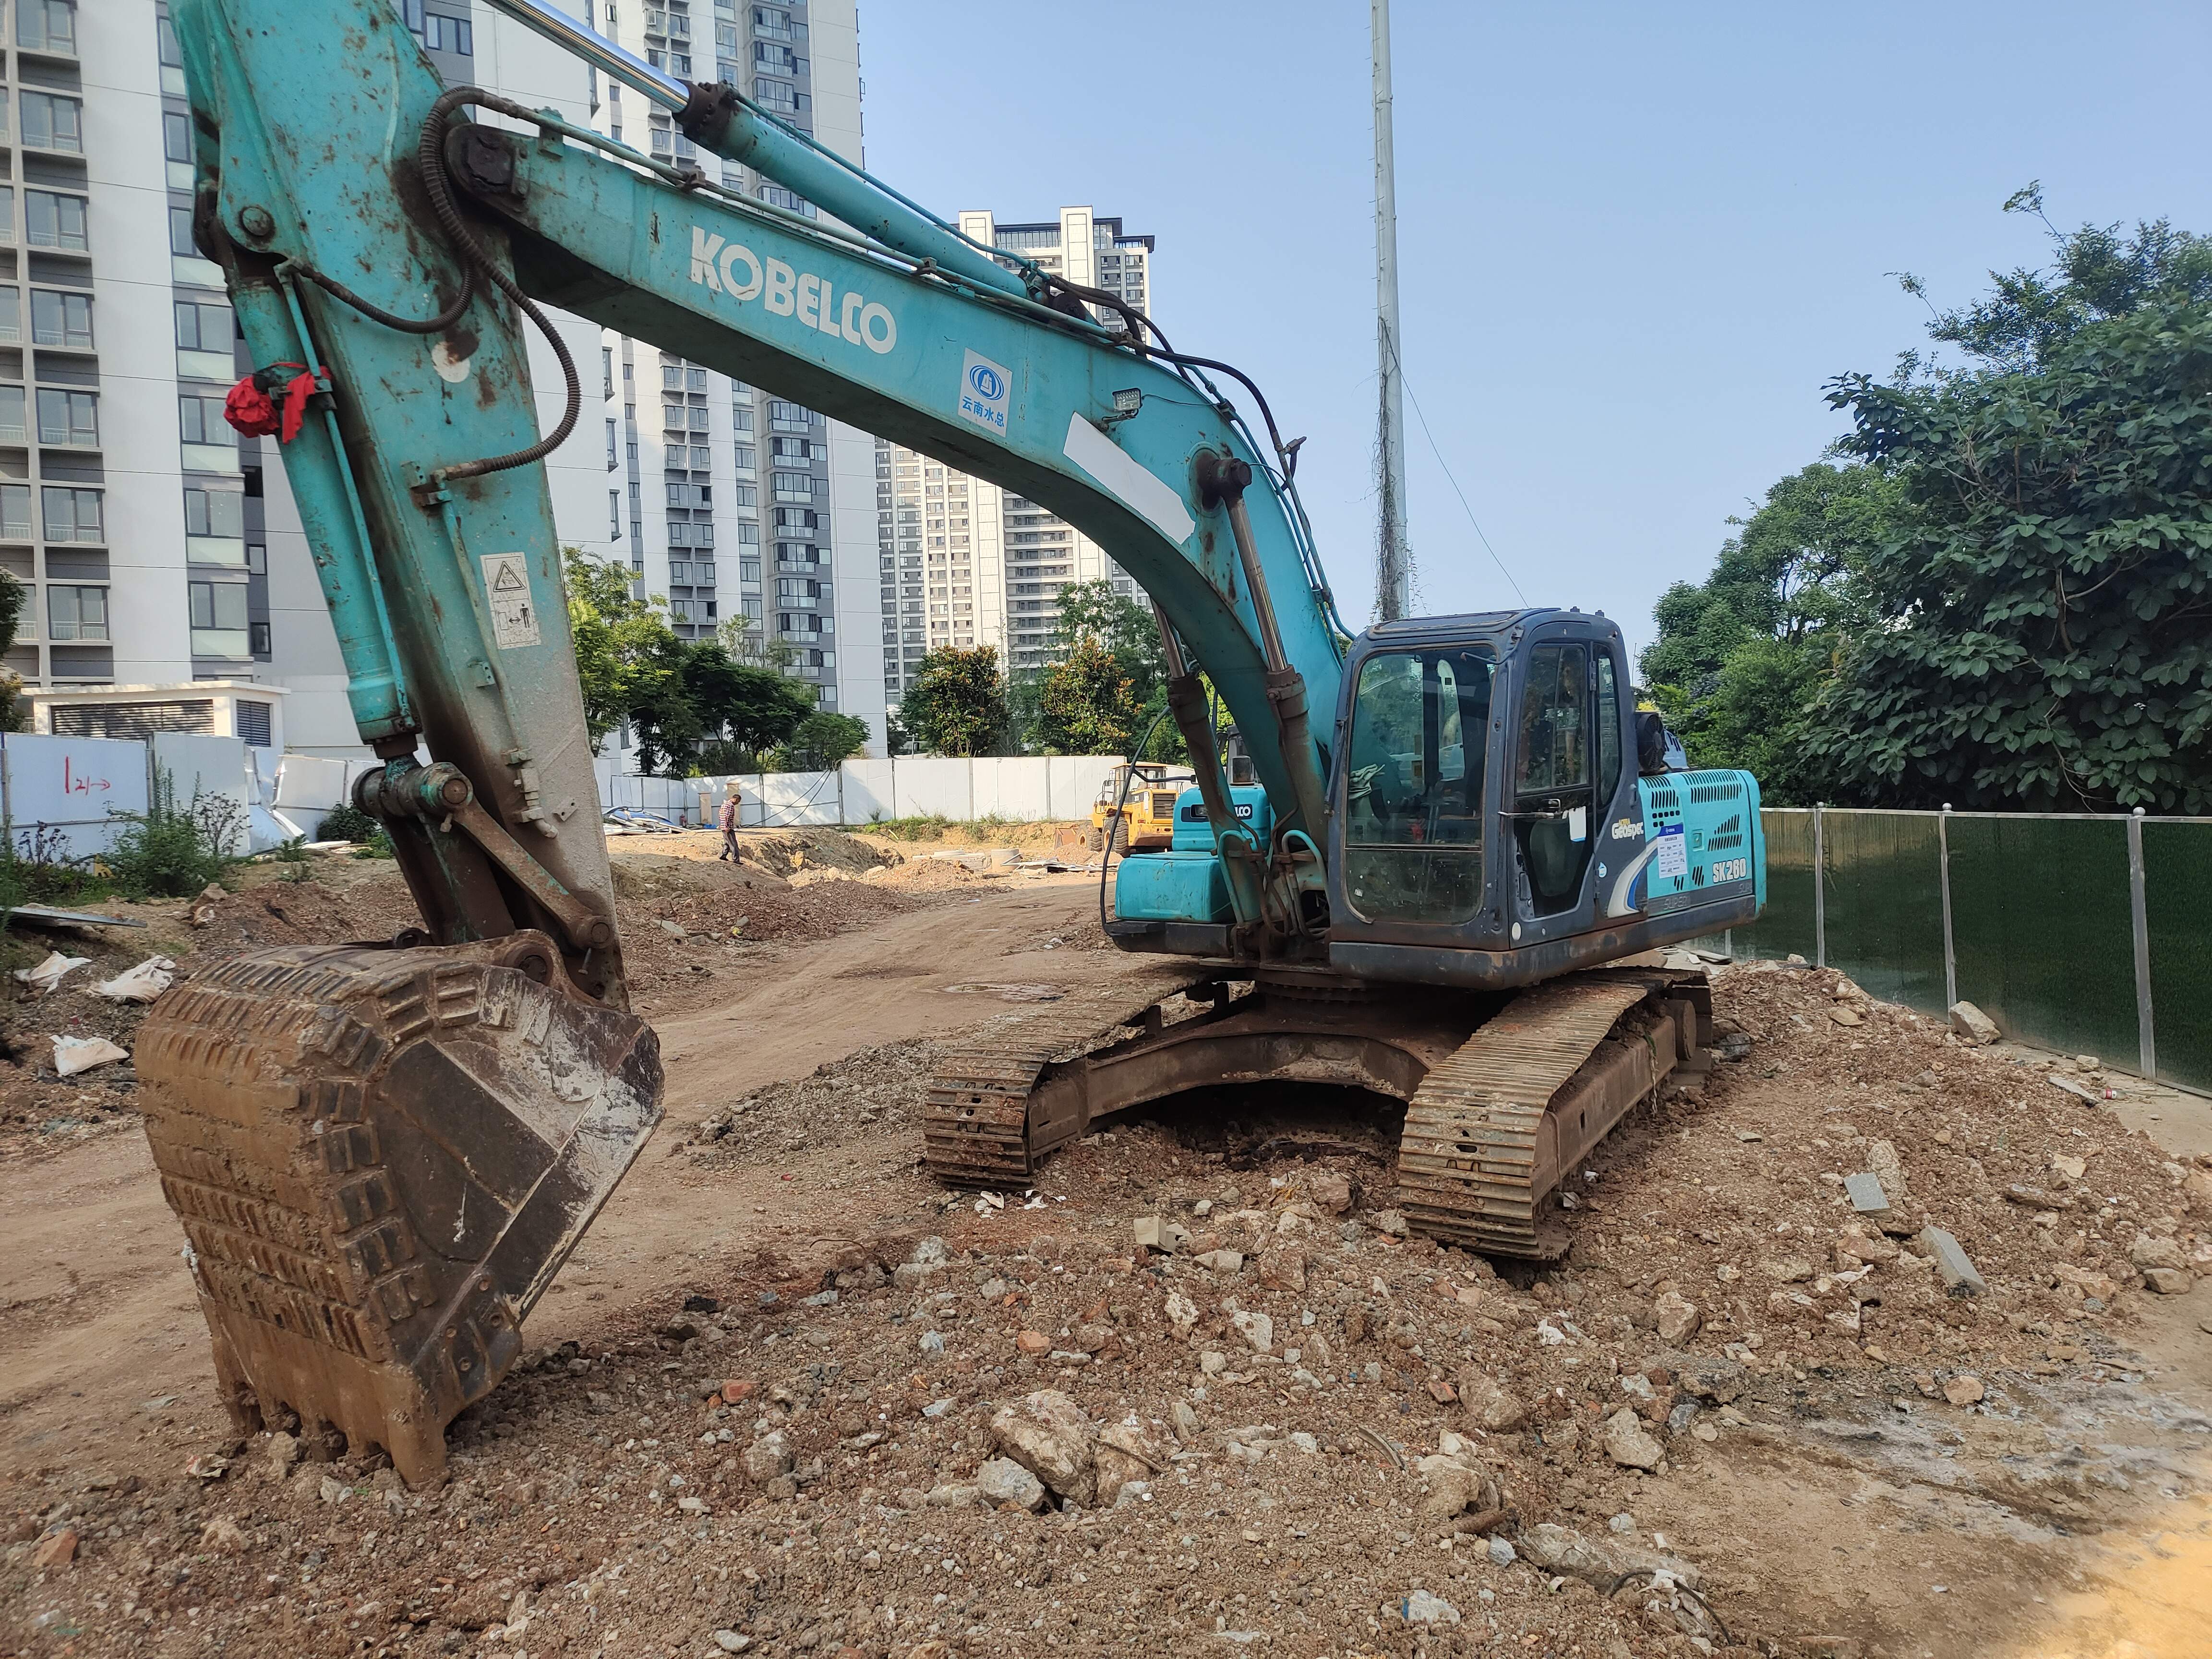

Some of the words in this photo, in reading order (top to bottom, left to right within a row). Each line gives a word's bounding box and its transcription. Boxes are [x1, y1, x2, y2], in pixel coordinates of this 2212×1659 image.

[691, 226, 897, 354] KOBELCO
[962, 396, 1004, 427] 云南水总
[1611, 821, 1644, 840] Geospec
[1712, 857, 1746, 883] SK260
